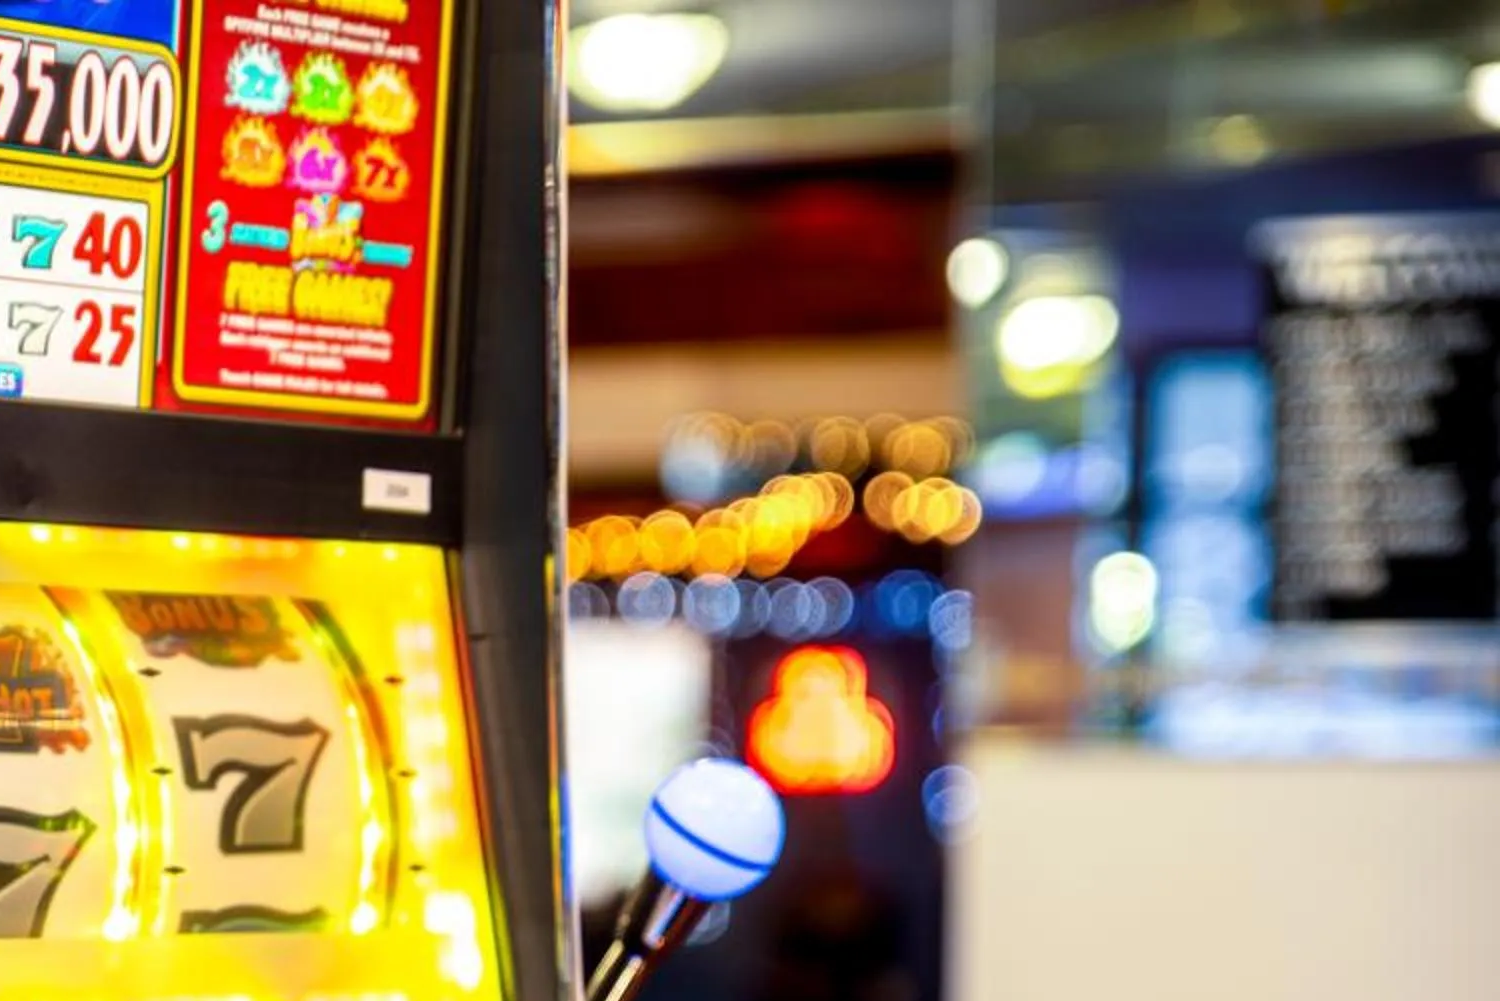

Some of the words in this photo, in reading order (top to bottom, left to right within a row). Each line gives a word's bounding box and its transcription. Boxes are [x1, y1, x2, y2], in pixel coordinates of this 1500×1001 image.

[12, 214, 68, 269] 7
[72, 210, 143, 279] 40
[72, 299, 136, 366] 25
[172, 713, 332, 855] 7
